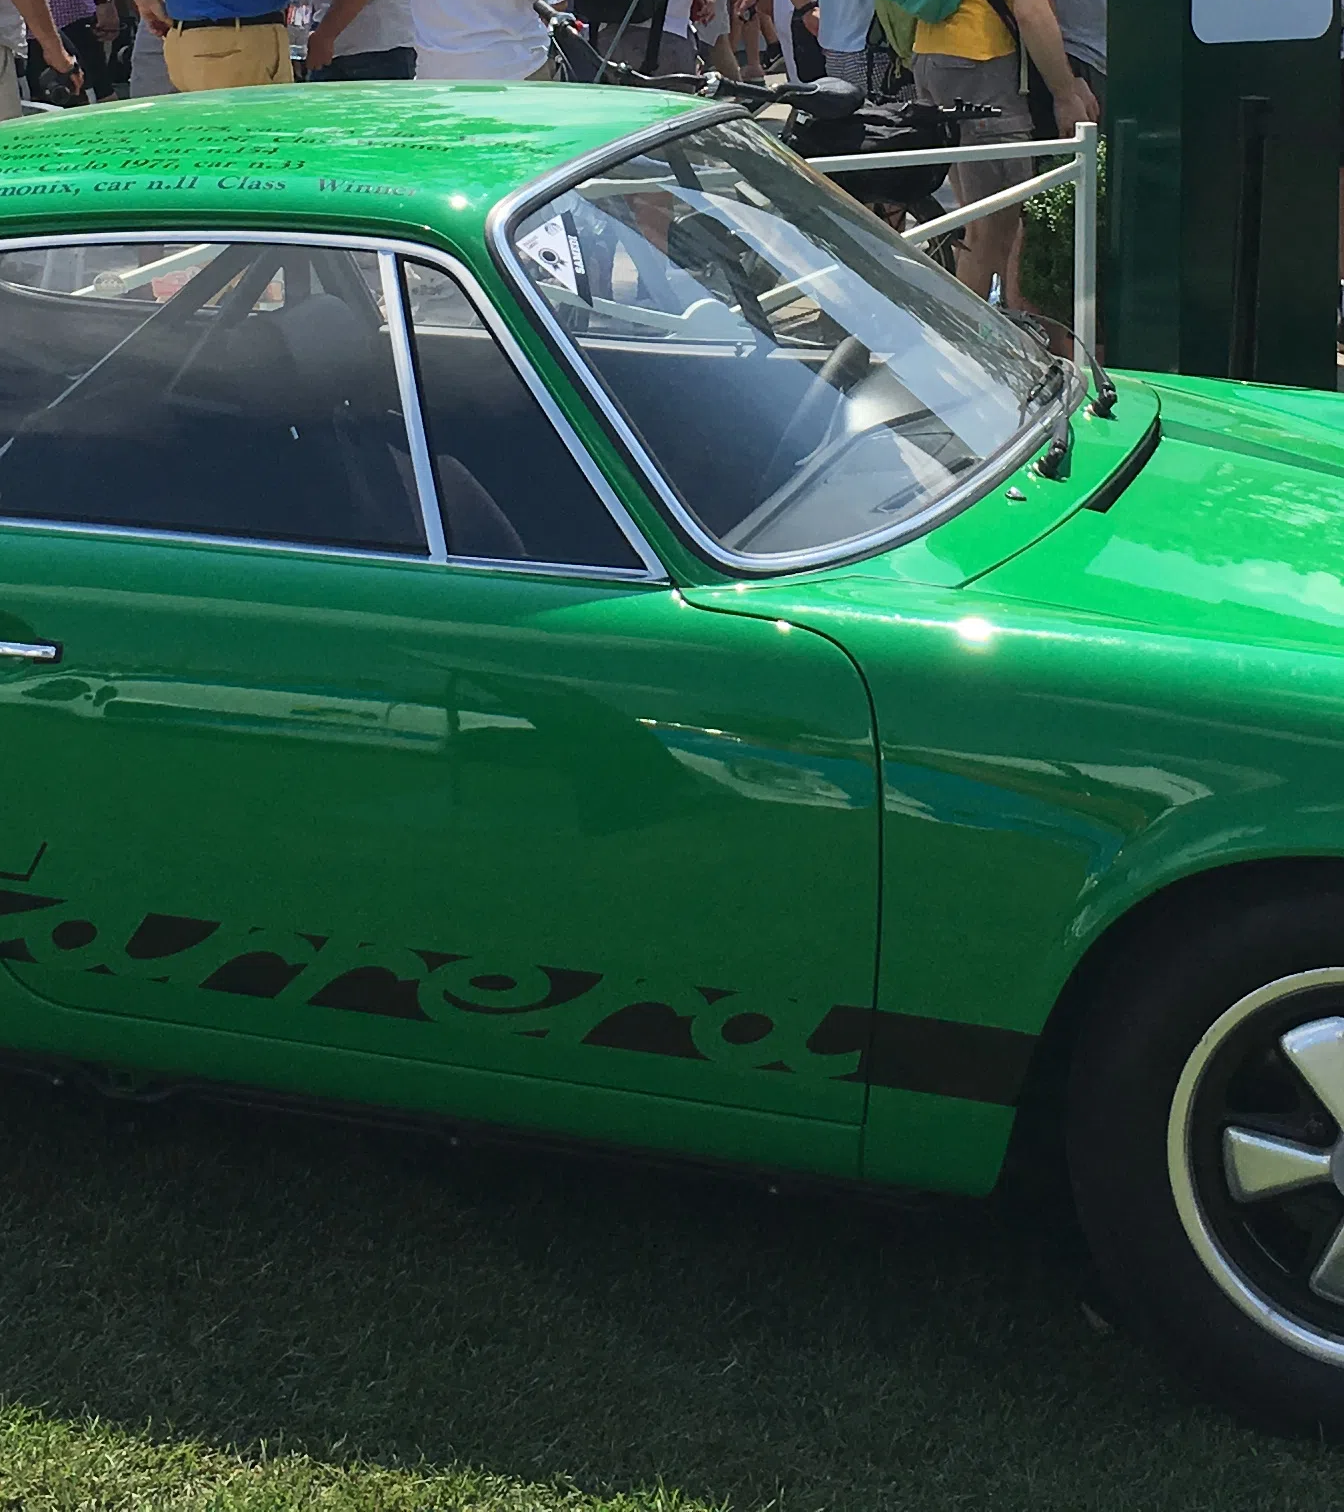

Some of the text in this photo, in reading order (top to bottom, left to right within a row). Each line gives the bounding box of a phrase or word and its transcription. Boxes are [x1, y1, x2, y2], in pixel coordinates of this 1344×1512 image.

[193, 159, 240, 170] car
[93, 179, 139, 193] car
[145, 174, 200, 191] n.11
[216, 174, 288, 192] Class
[318, 177, 419, 198] Winner
